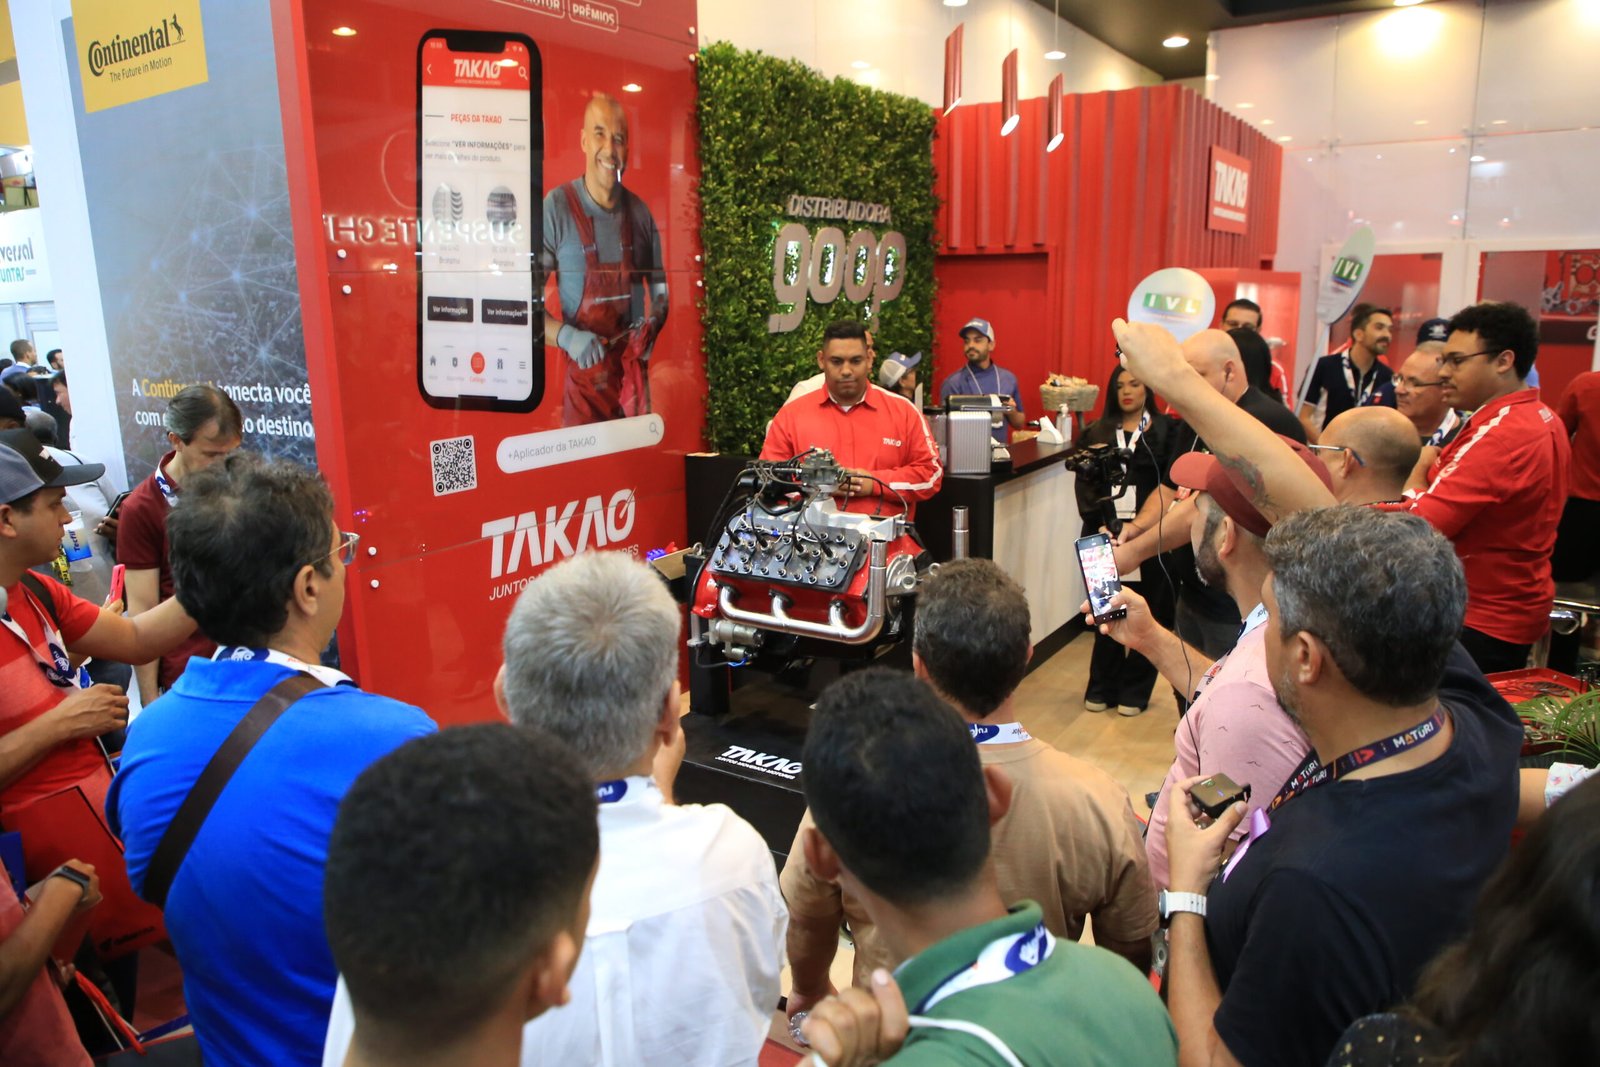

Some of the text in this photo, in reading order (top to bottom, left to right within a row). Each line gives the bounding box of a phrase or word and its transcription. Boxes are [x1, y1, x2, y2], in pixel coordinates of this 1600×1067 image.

[572, 4, 615, 25] PRÊMIOS
[88, 19, 170, 77] Continental
[110, 57, 172, 82] The Future in Motion
[453, 58, 501, 79] TAKAO
[451, 113, 502, 124] PEÇAS DA TAKAO
[1214, 160, 1248, 208] TAKAO
[788, 194, 892, 224] DISTRIBUIDORA
[1335, 259, 1360, 281] IVL
[1149, 294, 1196, 313] IVL
[132, 378, 142, 397] A
[274, 383, 312, 404] você
[135, 411, 160, 426] com
[556, 442, 567, 452] da
[568, 436, 596, 449] TAKAO
[481, 487, 636, 579] TAKAO
[721, 744, 802, 774] TAKAO
